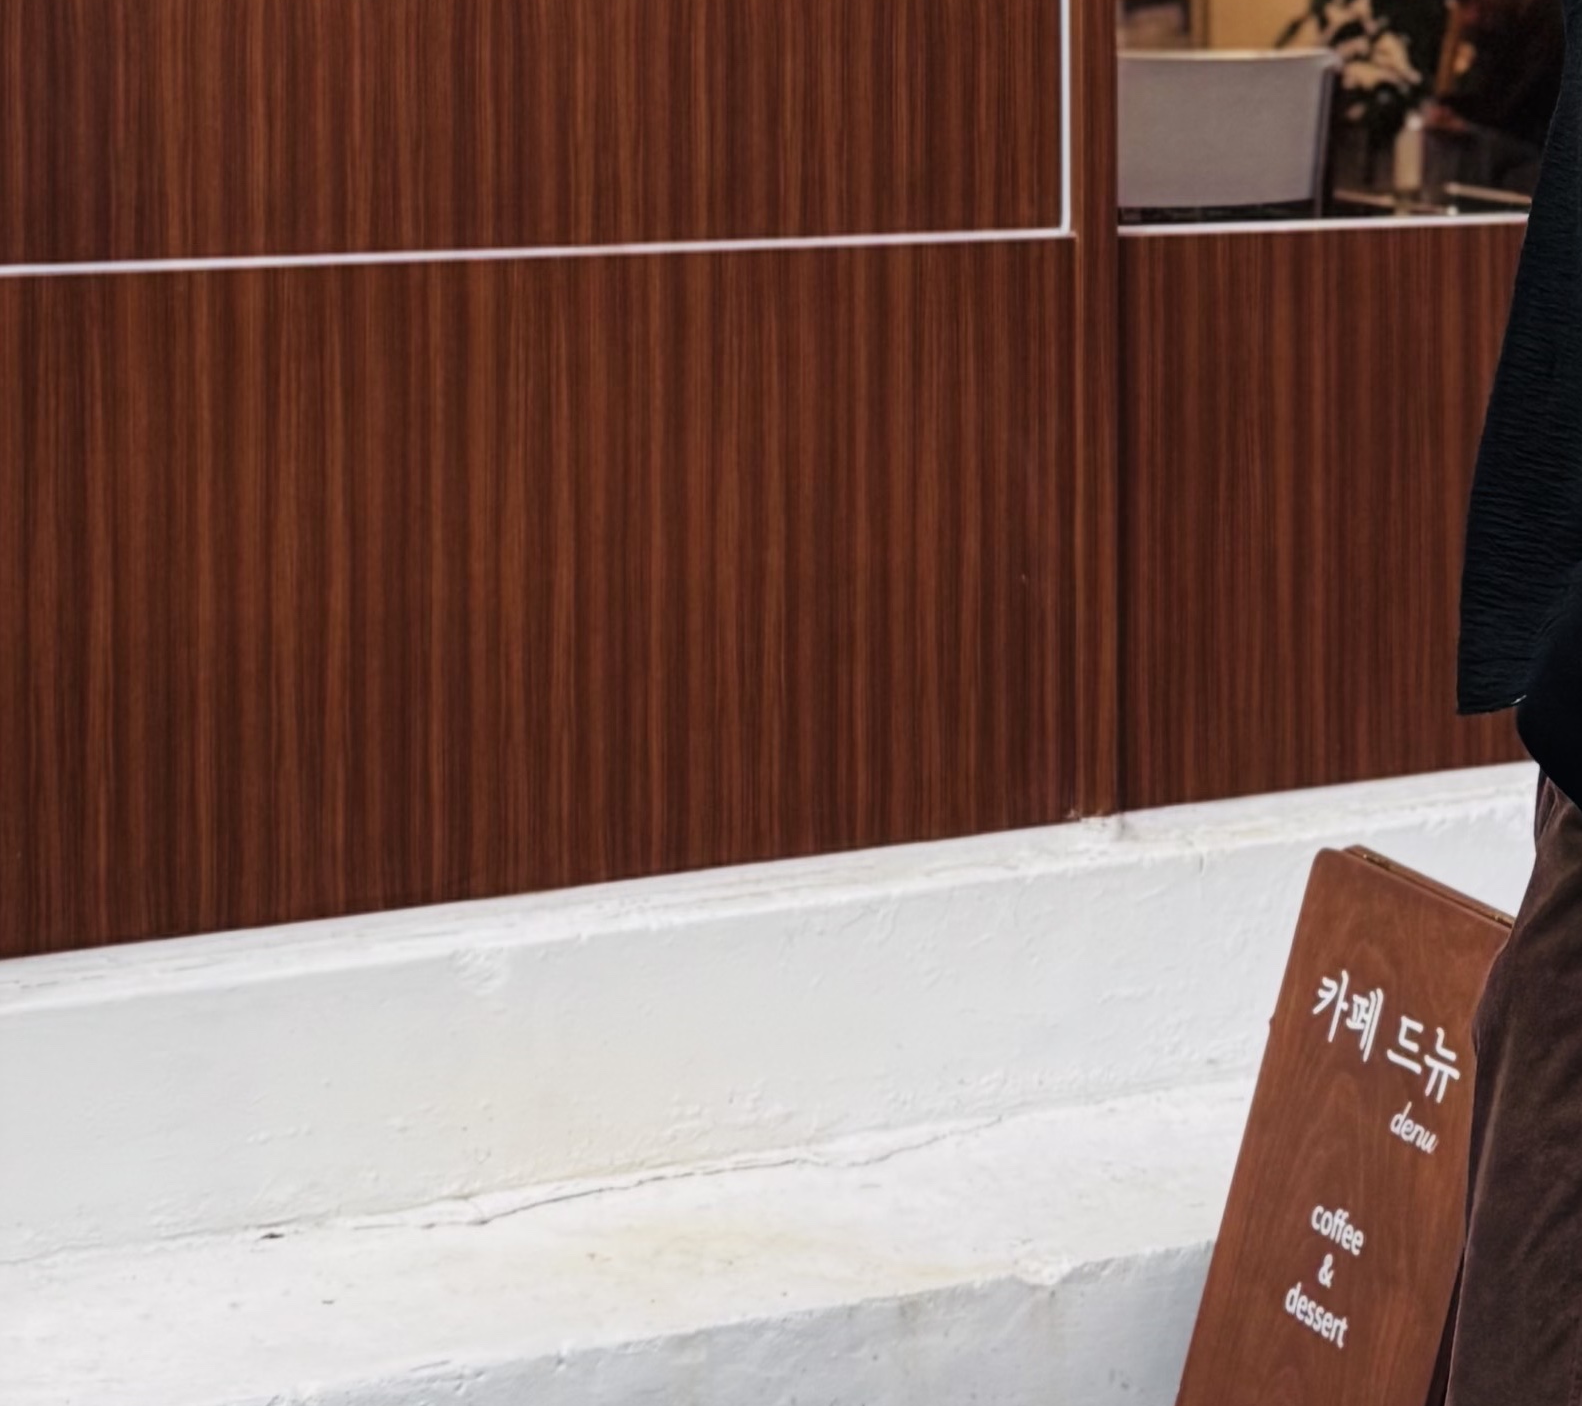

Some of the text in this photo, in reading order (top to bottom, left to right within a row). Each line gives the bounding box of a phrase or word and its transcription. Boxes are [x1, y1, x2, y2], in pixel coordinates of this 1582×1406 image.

[1312, 969, 1461, 1104] 카페 드뉴
[1390, 1101, 1439, 1154] denu
[1311, 1205, 1364, 1256] coffee
[1318, 1253, 1334, 1288] &
[1285, 1282, 1348, 1349] dessert
